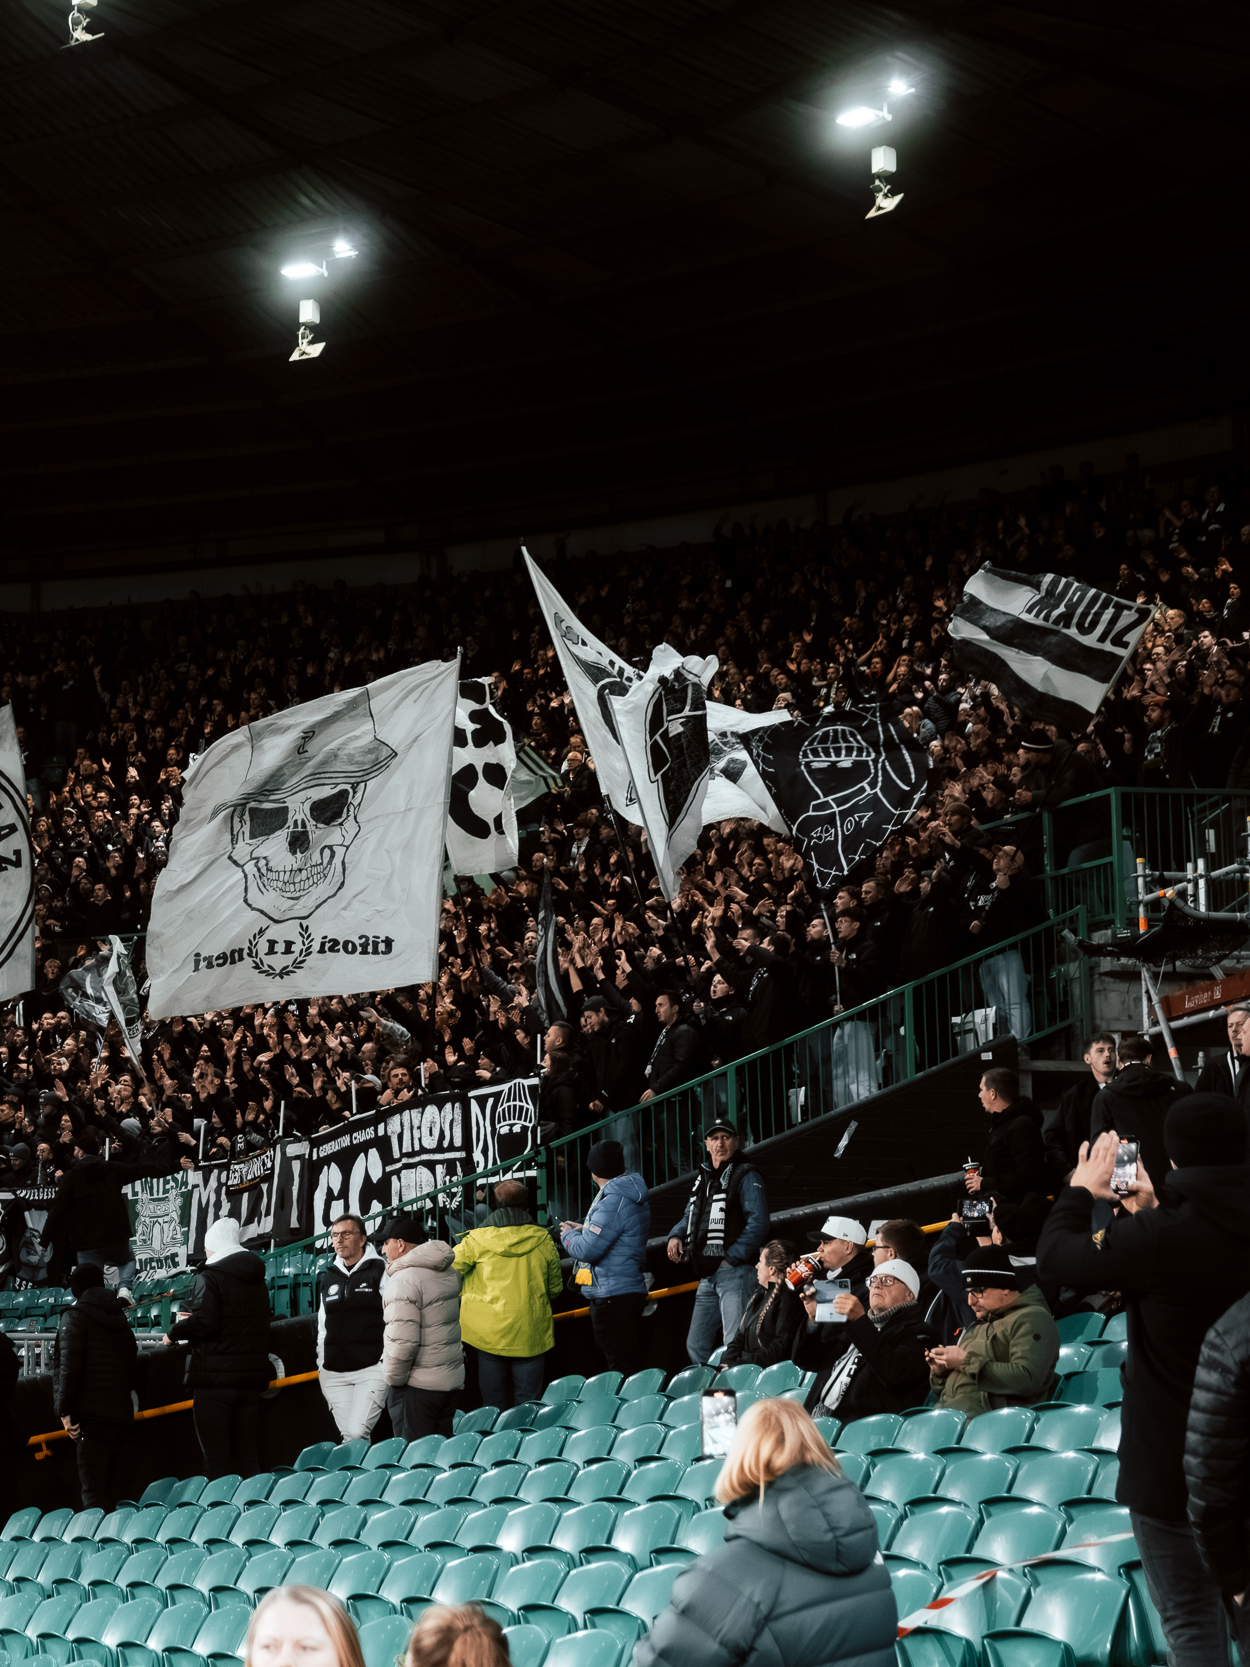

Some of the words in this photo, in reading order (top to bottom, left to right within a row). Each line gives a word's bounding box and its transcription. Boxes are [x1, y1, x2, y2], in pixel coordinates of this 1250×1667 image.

[319, 1136, 351, 1158] GENERATION
[352, 1126, 375, 1145] CHAOS
[386, 1102, 463, 1159] TIFOSI
